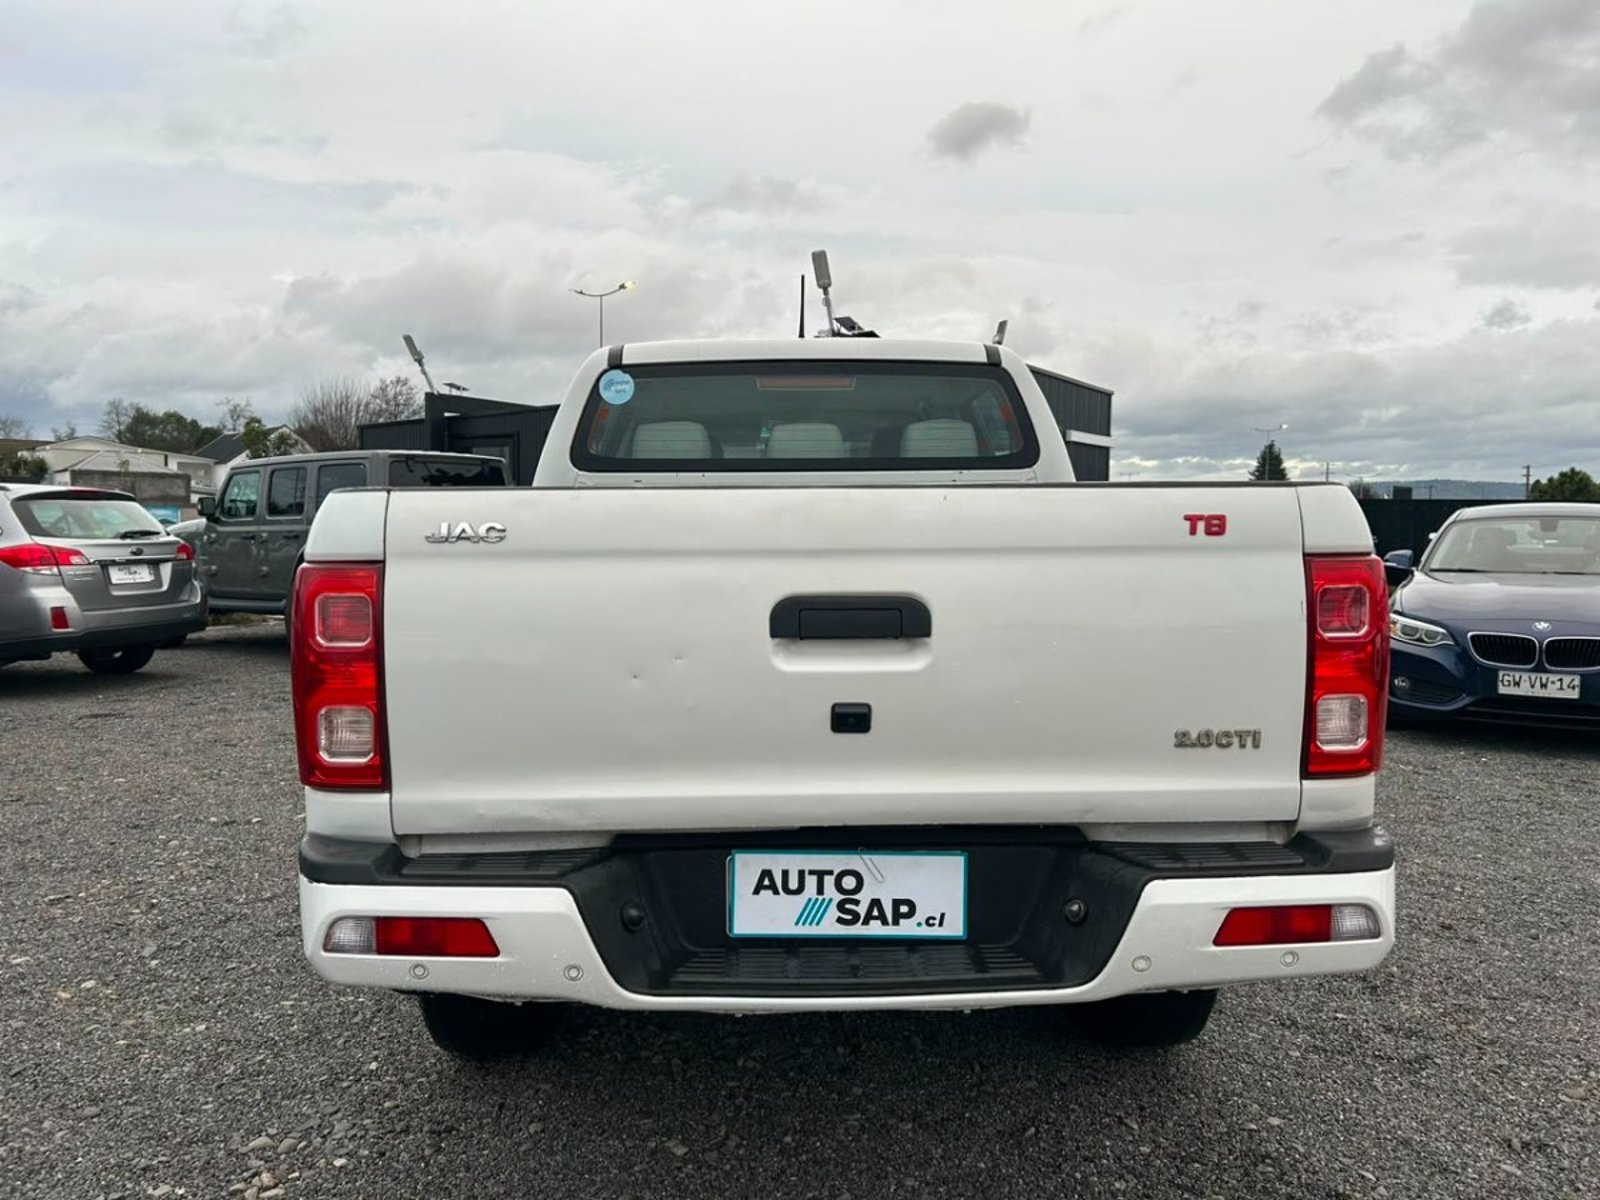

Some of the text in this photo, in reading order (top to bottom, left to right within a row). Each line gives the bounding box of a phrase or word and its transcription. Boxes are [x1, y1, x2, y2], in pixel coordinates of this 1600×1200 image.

[424, 521, 507, 544] JAC
[1183, 513, 1227, 536] T8
[1173, 728, 1262, 749] 2.0CTI
[752, 868, 865, 897] AUTO
[835, 897, 946, 928] SAP.cl
